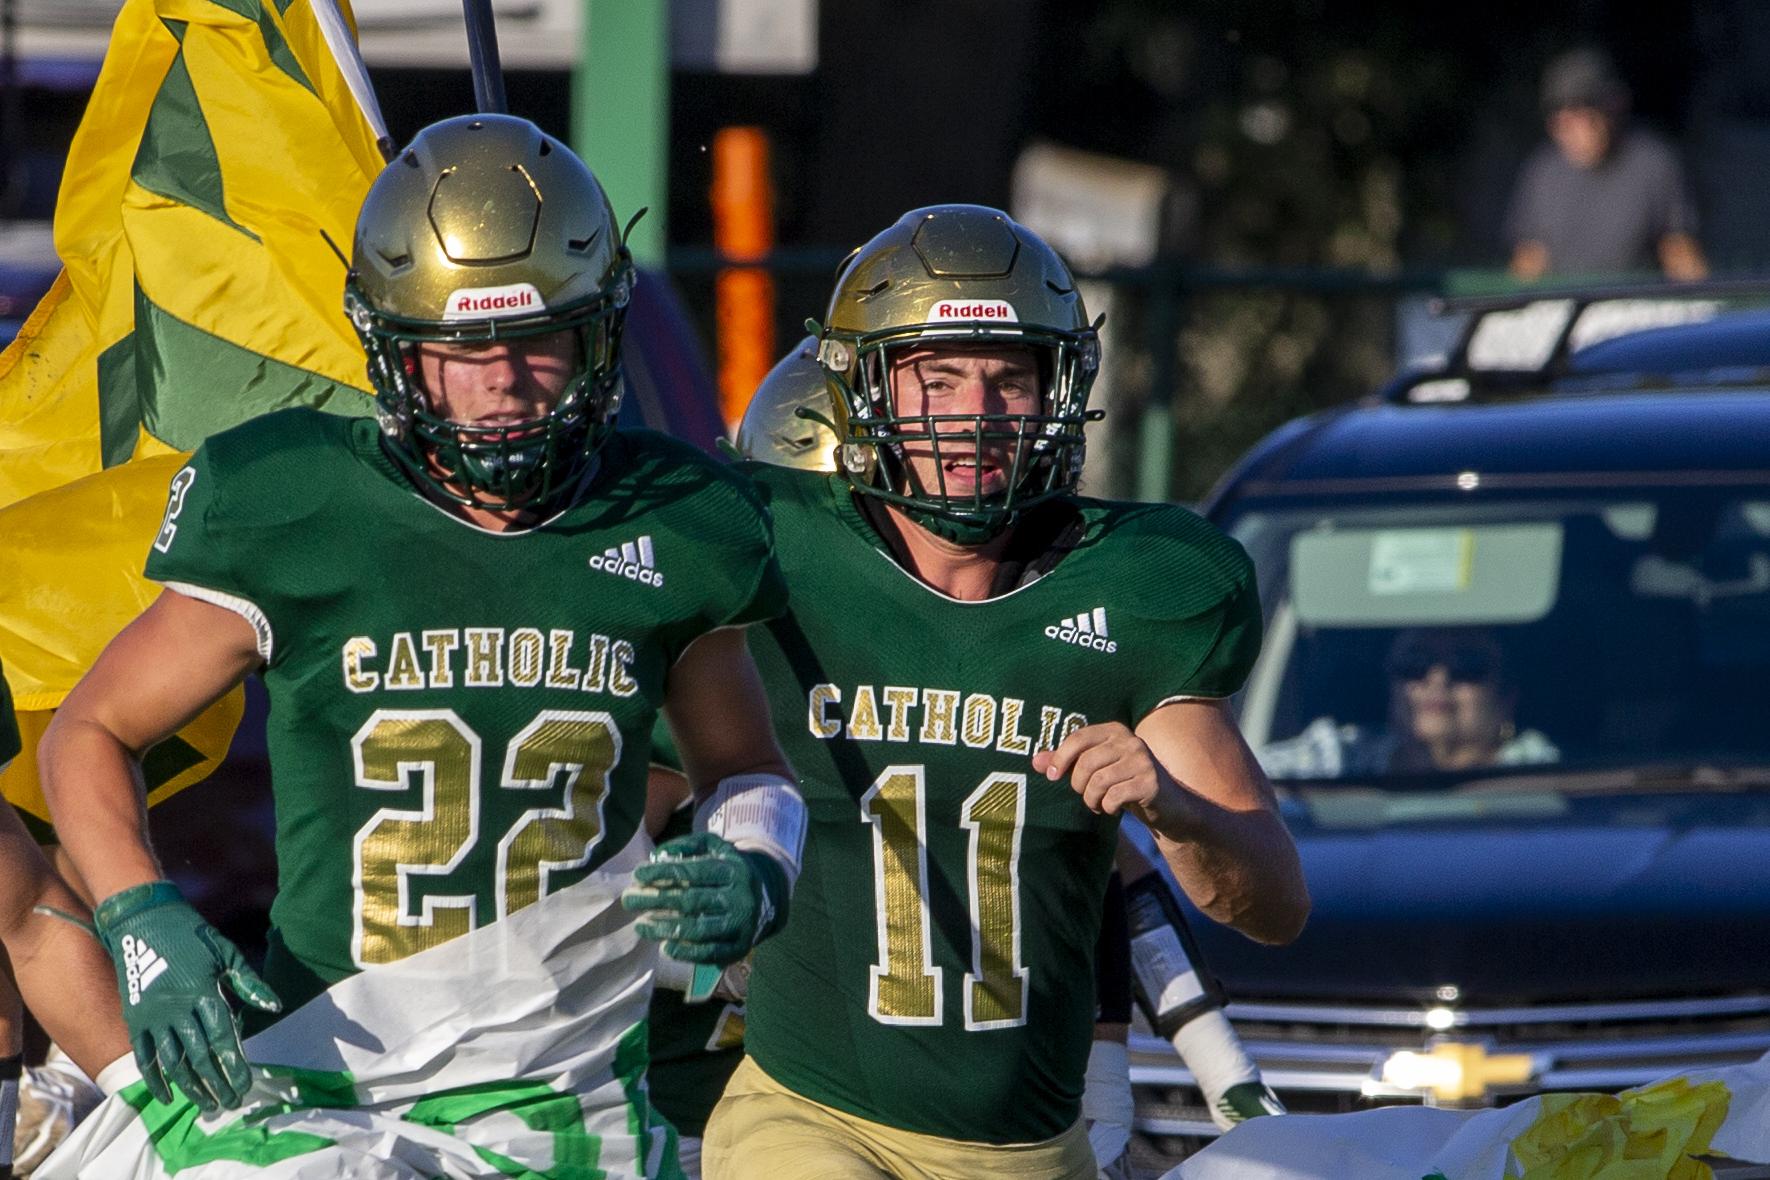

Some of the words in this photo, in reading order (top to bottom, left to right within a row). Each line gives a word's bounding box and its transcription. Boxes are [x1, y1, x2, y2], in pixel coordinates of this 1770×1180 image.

[457, 292, 532, 311] Riddell
[939, 304, 1008, 318] Riddell
[589, 554, 663, 587] adidas
[342, 627, 639, 697] CATHOLIC
[1044, 623, 1117, 653] adidas
[351, 708, 623, 970] 22
[861, 764, 1030, 1031] 11
[121, 934, 141, 1006] adidas
